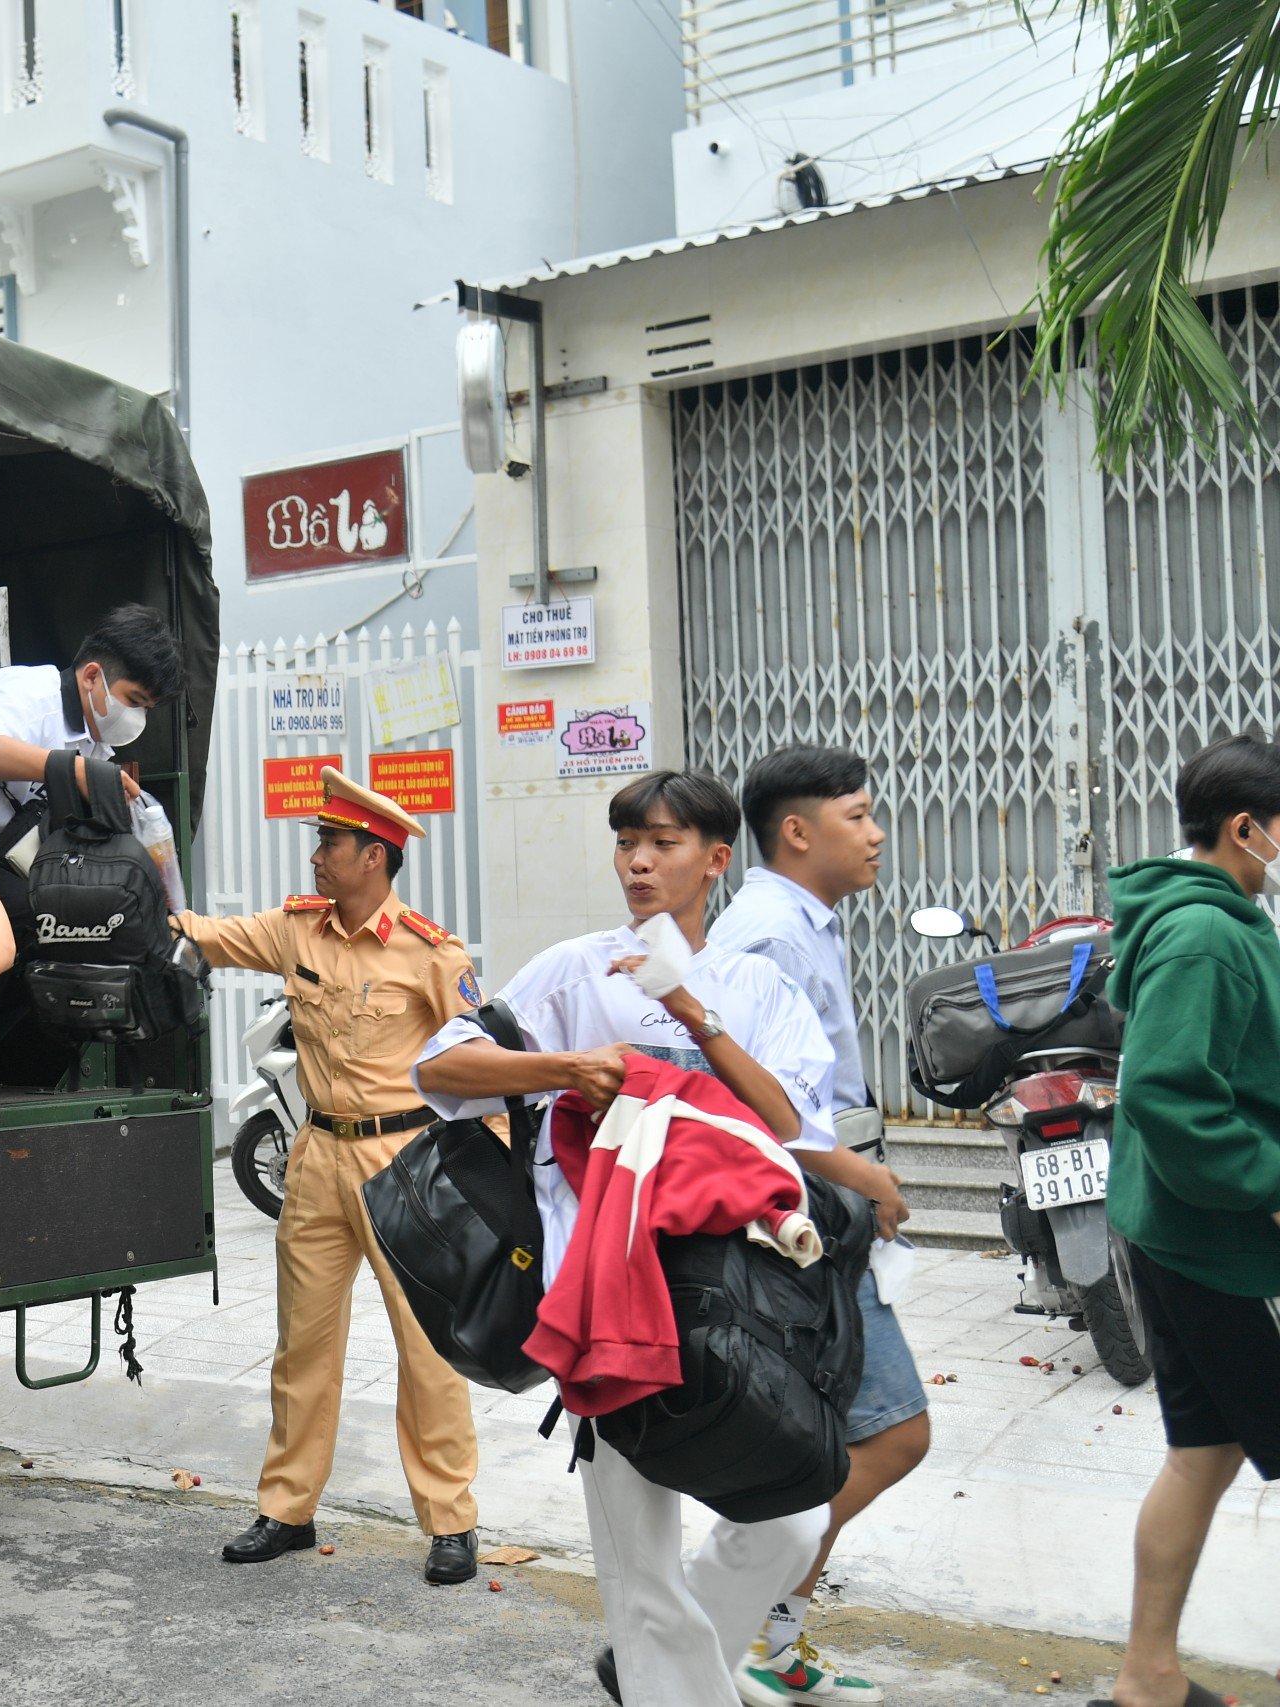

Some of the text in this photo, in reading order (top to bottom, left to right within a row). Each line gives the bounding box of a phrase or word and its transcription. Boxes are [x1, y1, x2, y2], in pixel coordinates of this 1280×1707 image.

[522, 610, 543, 624] CHO
[545, 626, 571, 642] PHÒNG
[573, 626, 587, 642] TRỌ
[508, 645, 588, 662] LH: 0908 04 69 96
[273, 683, 292, 708] NHÀ
[296, 688, 314, 712] TRỌ
[317, 680, 328, 707] HỒ
[506, 702, 546, 716] CẢNH BÁO
[272, 716, 286, 730] LH:
[288, 716, 328, 730] 0908.046
[578, 766, 602, 774] 0908
[1033, 1170, 1107, 1204] 391.05
